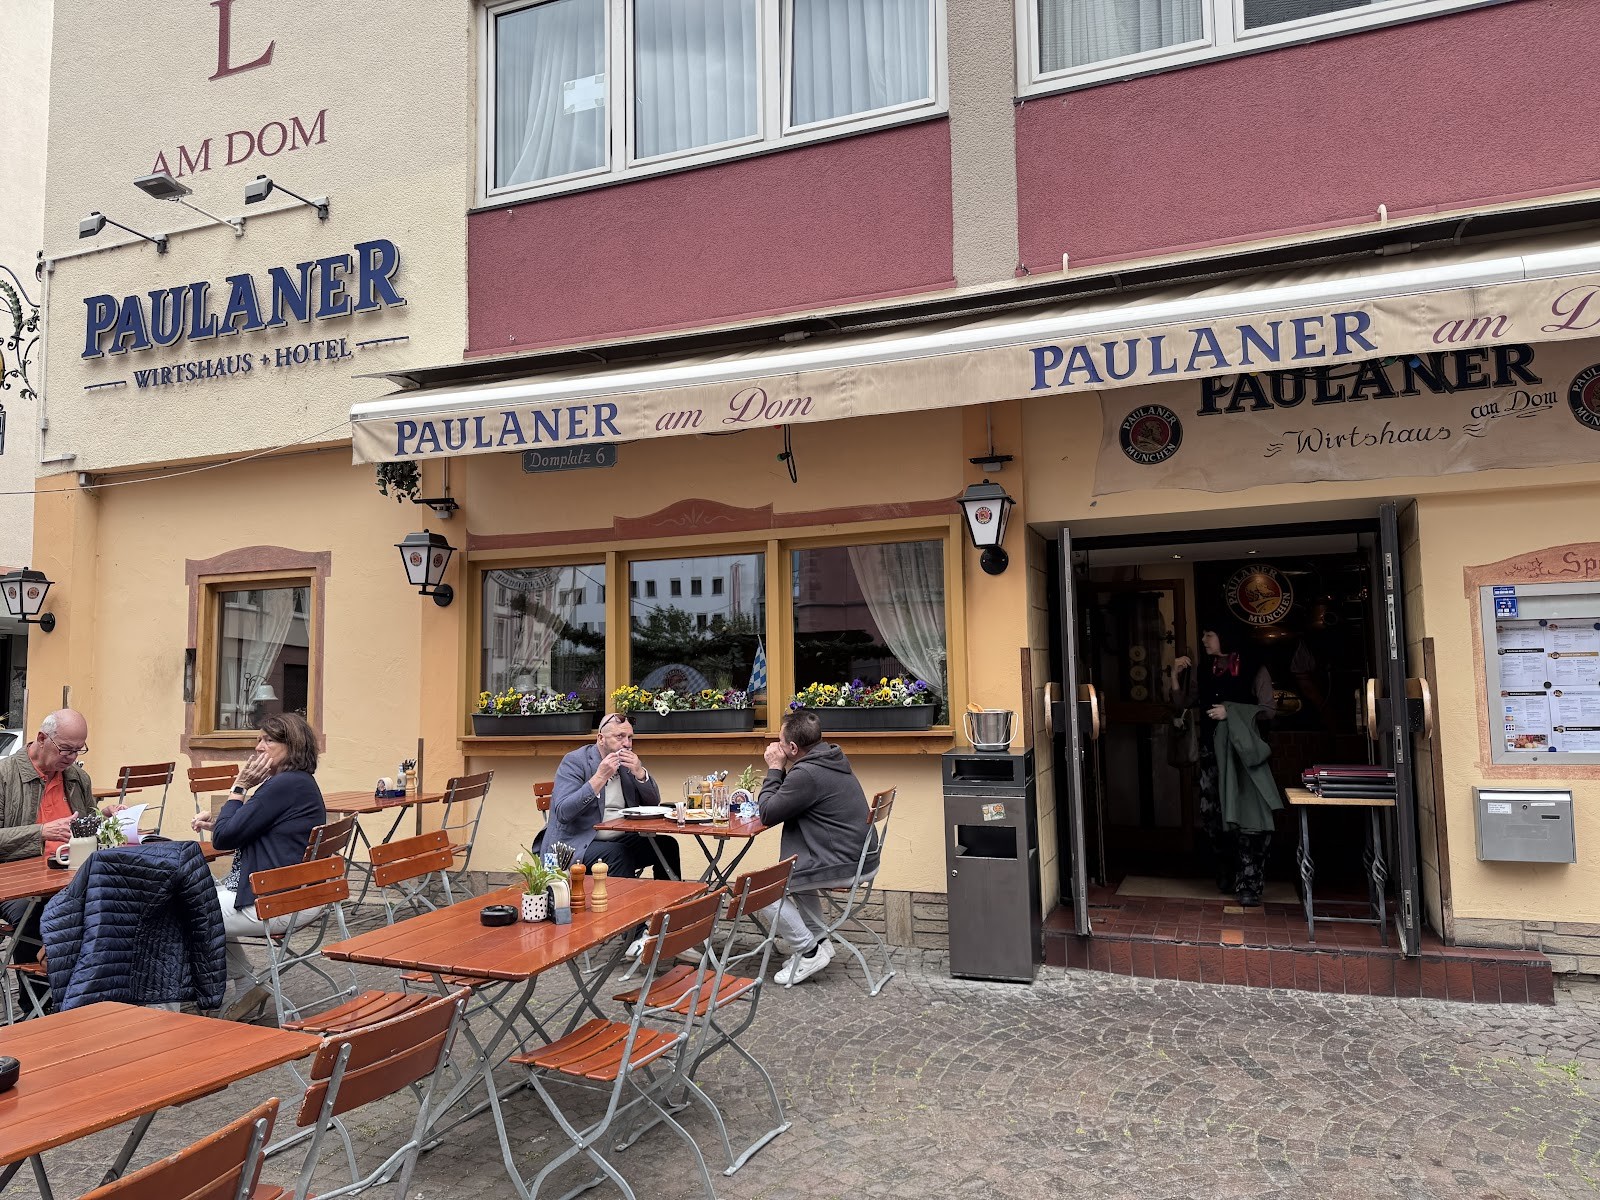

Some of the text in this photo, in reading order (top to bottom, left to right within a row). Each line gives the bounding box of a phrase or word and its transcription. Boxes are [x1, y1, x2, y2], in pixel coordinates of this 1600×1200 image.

[151, 108, 329, 178] AM DOM
[81, 238, 407, 360] PAULANER
[133, 353, 251, 389] WIRTSHAUS
[275, 338, 352, 368] HOTEL
[1029, 310, 1378, 391] PAULANER
[1432, 314, 1514, 345] am
[1196, 343, 1543, 416] PAULANER
[1504, 390, 1558, 412] Dom
[394, 386, 815, 457] PAULANER am Dom
[1122, 406, 1177, 430] PAULANER
[1283, 421, 1452, 455] Wirtshaus
[529, 447, 606, 468] Domplatz 6
[1227, 565, 1278, 606] PAULANER
[1559, 551, 1600, 579] Sp
